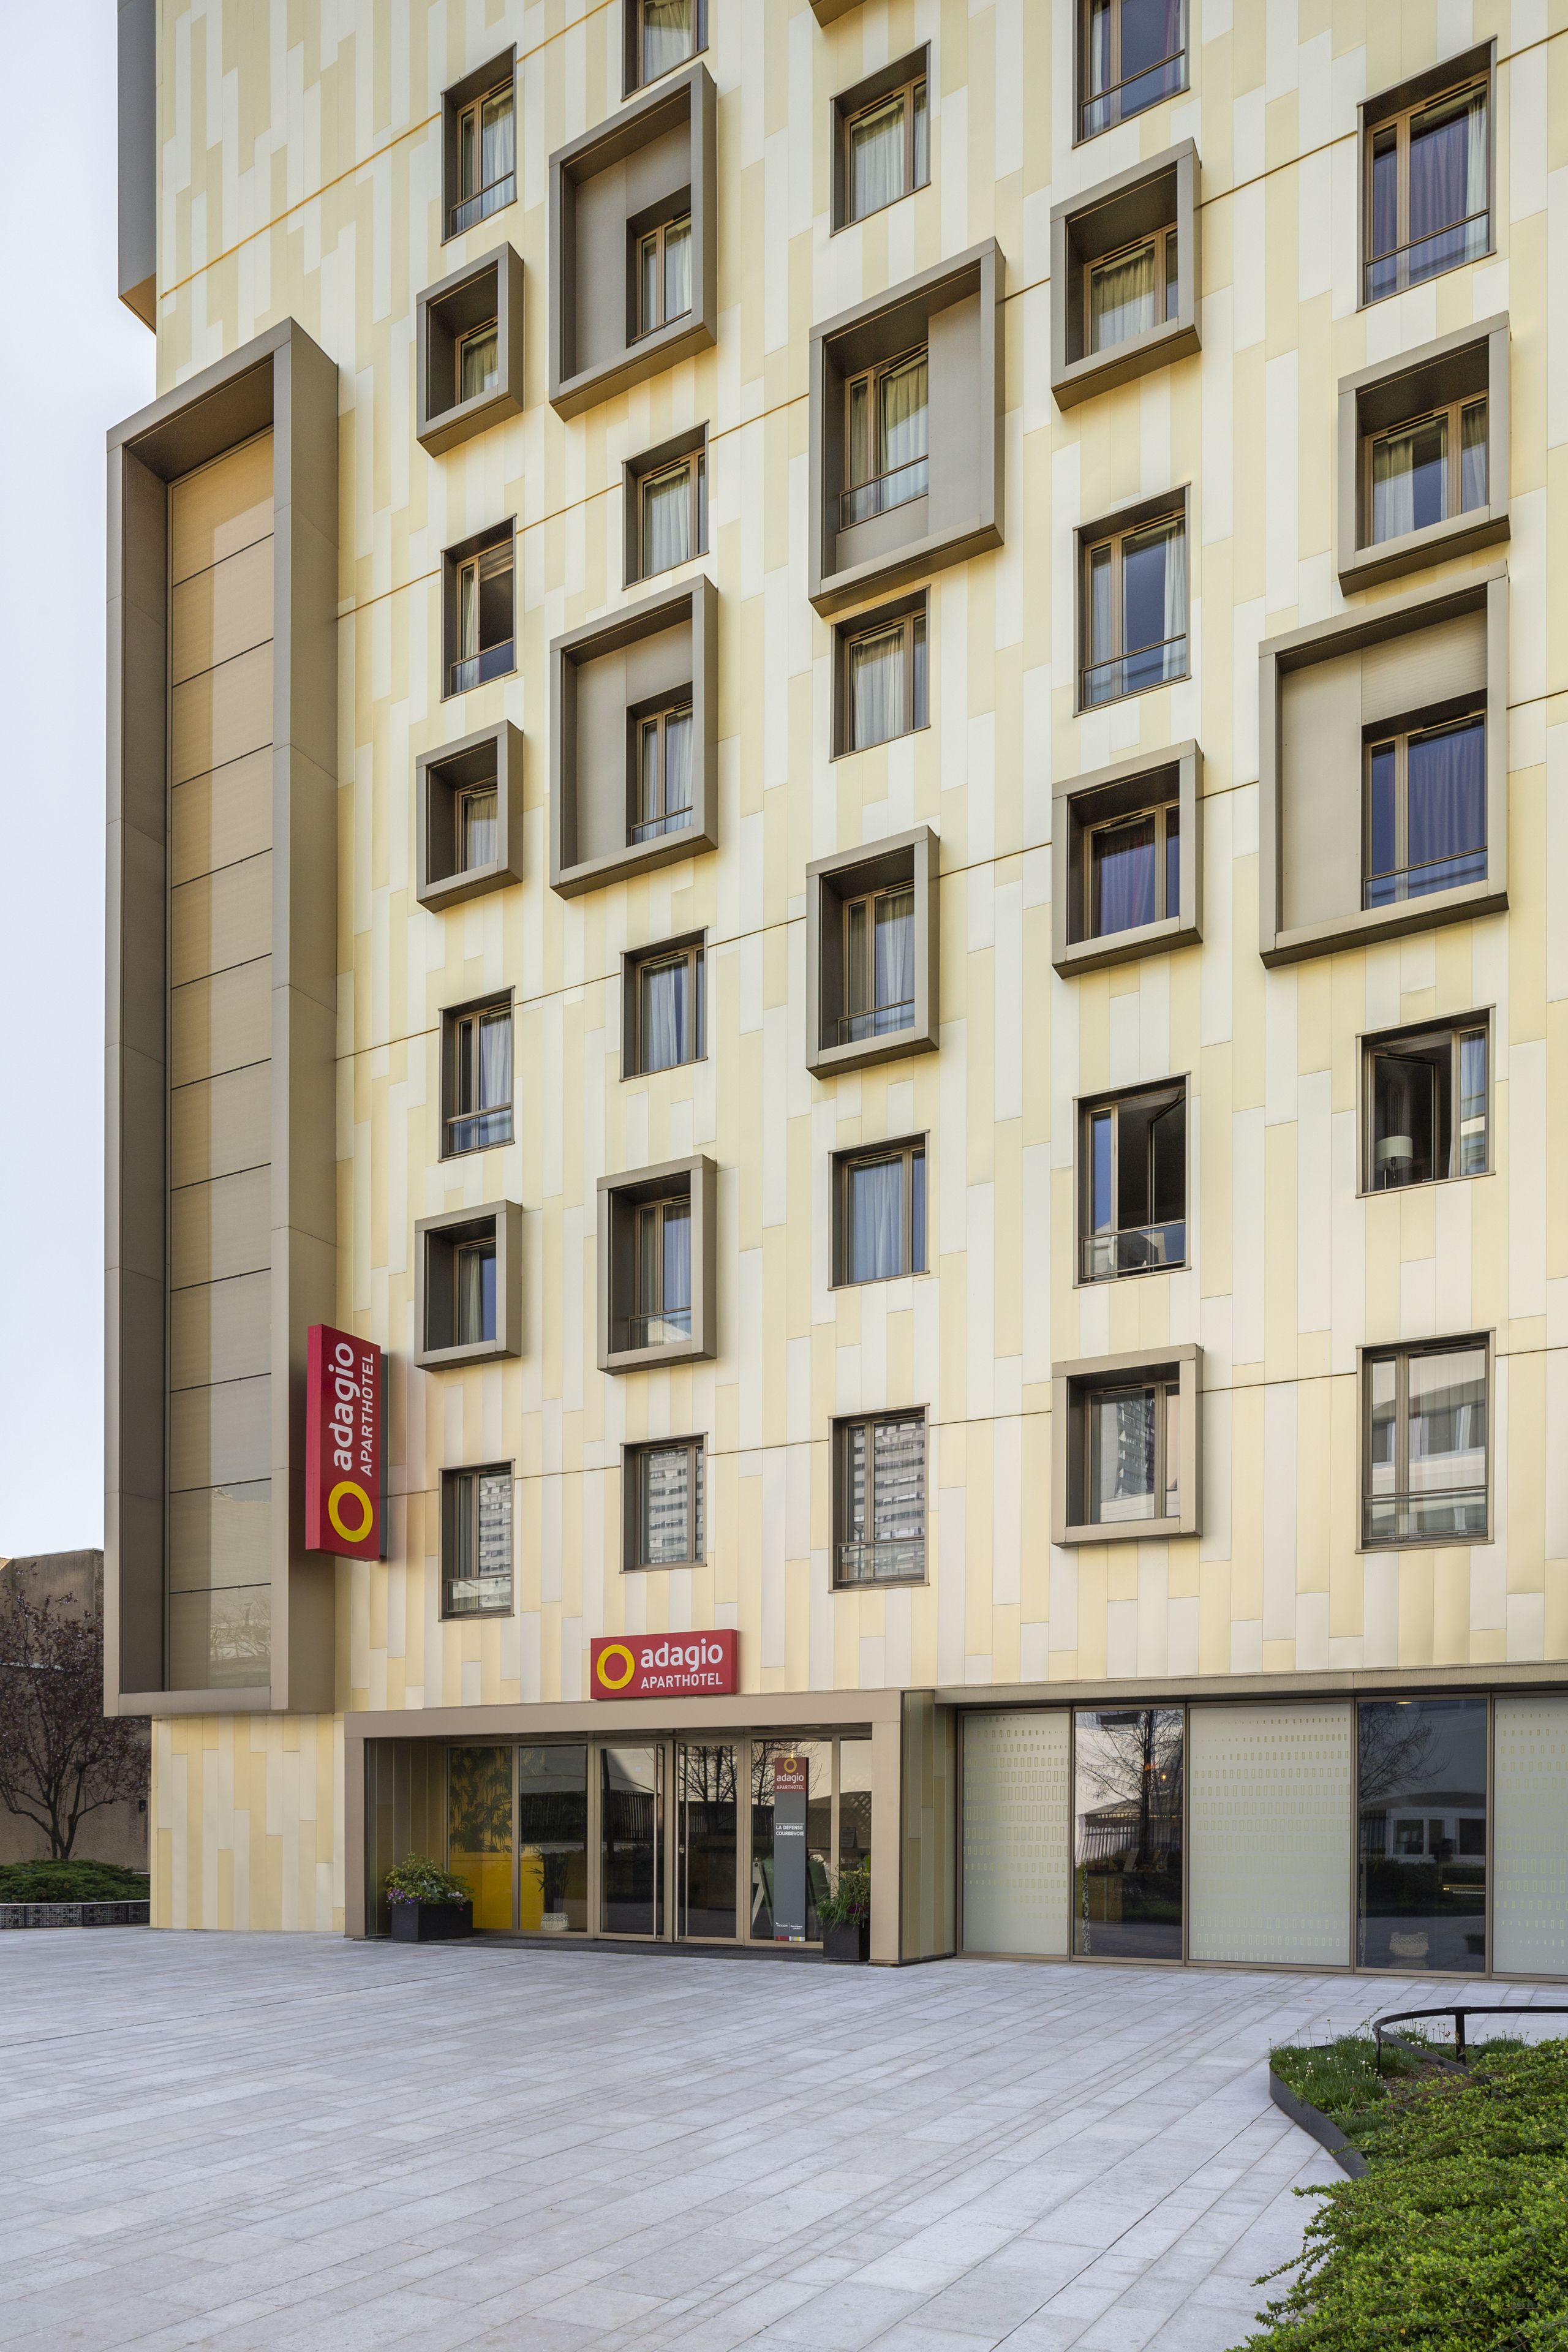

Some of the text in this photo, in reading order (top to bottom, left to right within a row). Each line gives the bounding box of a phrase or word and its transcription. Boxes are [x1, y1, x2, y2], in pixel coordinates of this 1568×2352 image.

[328, 1343, 360, 1471] adagio
[361, 1353, 374, 1477] APARTHOTEL
[641, 1638, 723, 1672] adagio
[641, 1673, 723, 1689] APARTHOTEL
[776, 1773, 804, 1784] adagio
